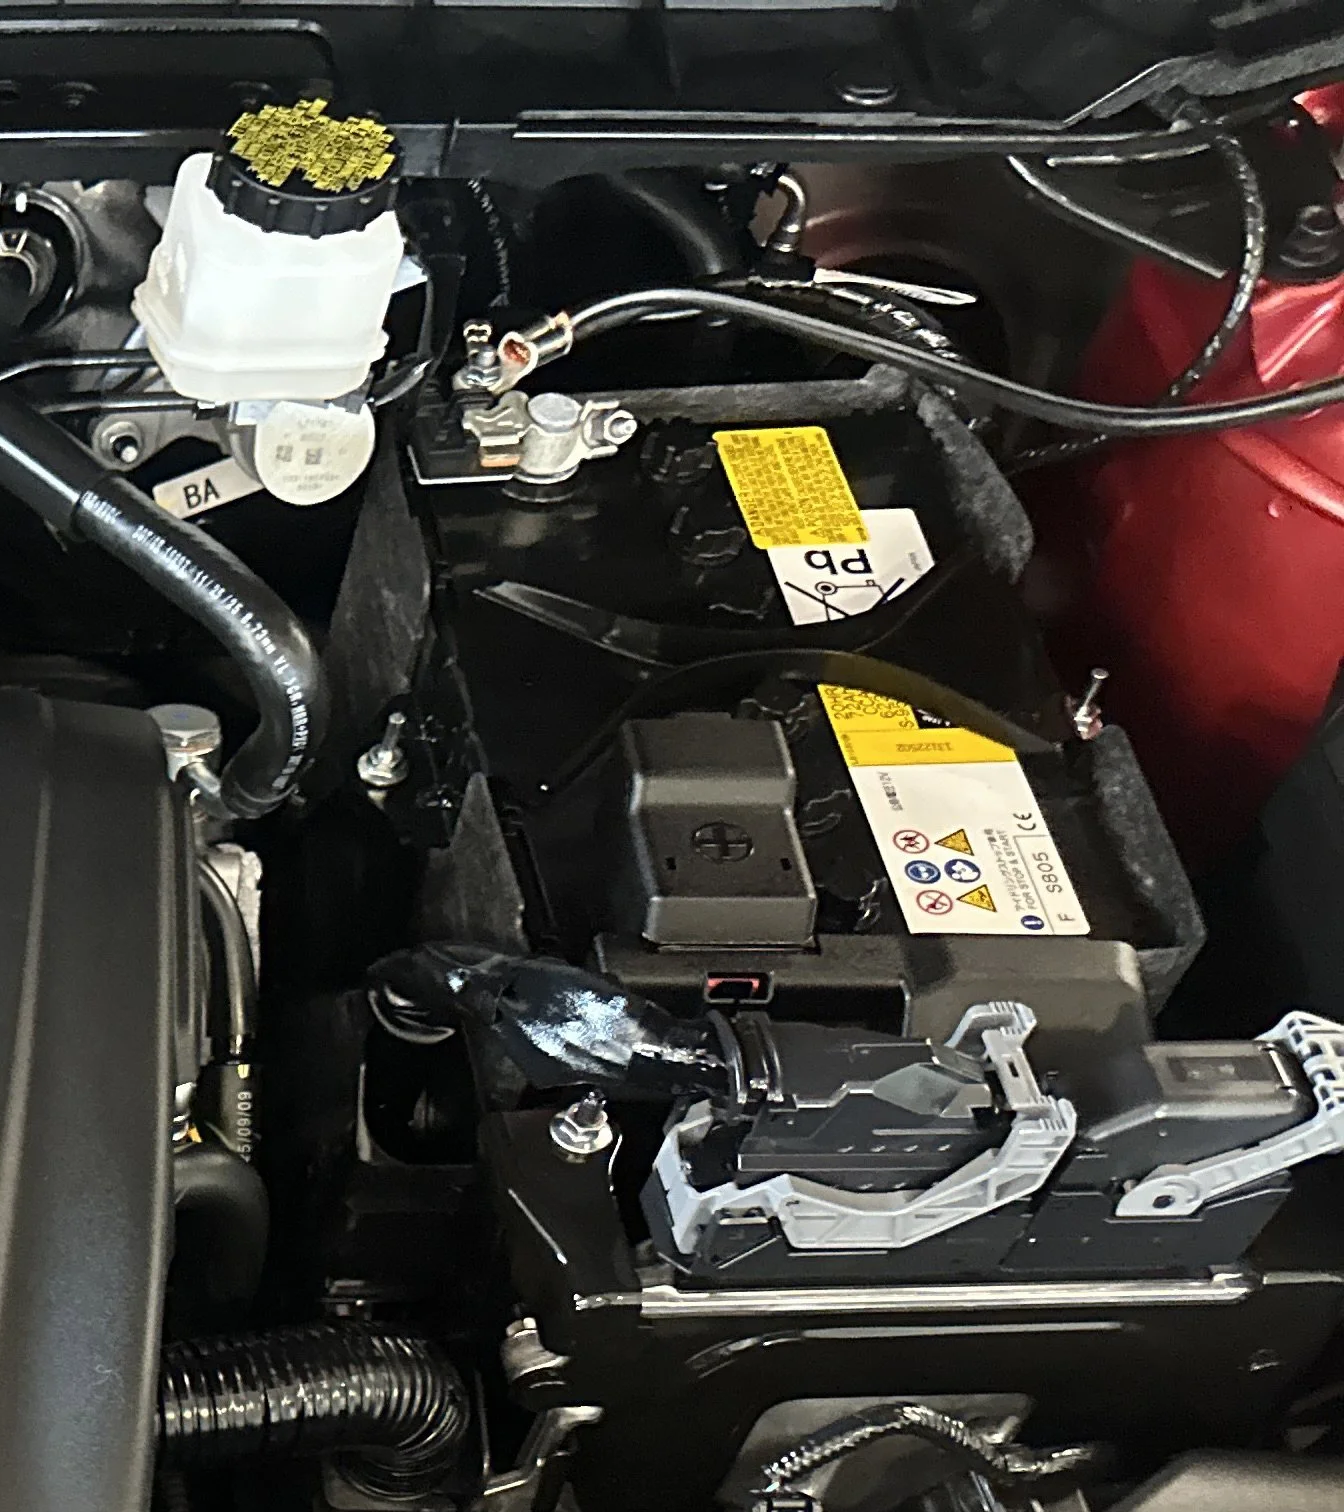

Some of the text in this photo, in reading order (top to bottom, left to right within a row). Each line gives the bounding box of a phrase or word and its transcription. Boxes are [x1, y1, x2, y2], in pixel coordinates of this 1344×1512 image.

[183, 478, 221, 509] BA
[804, 549, 873, 575] Pb
[1013, 812, 1037, 831] CE
[996, 829, 1016, 857] START
[1012, 867, 1030, 890] STOP
[1033, 852, 1076, 922] F S805
[1022, 892, 1038, 910] FOR
